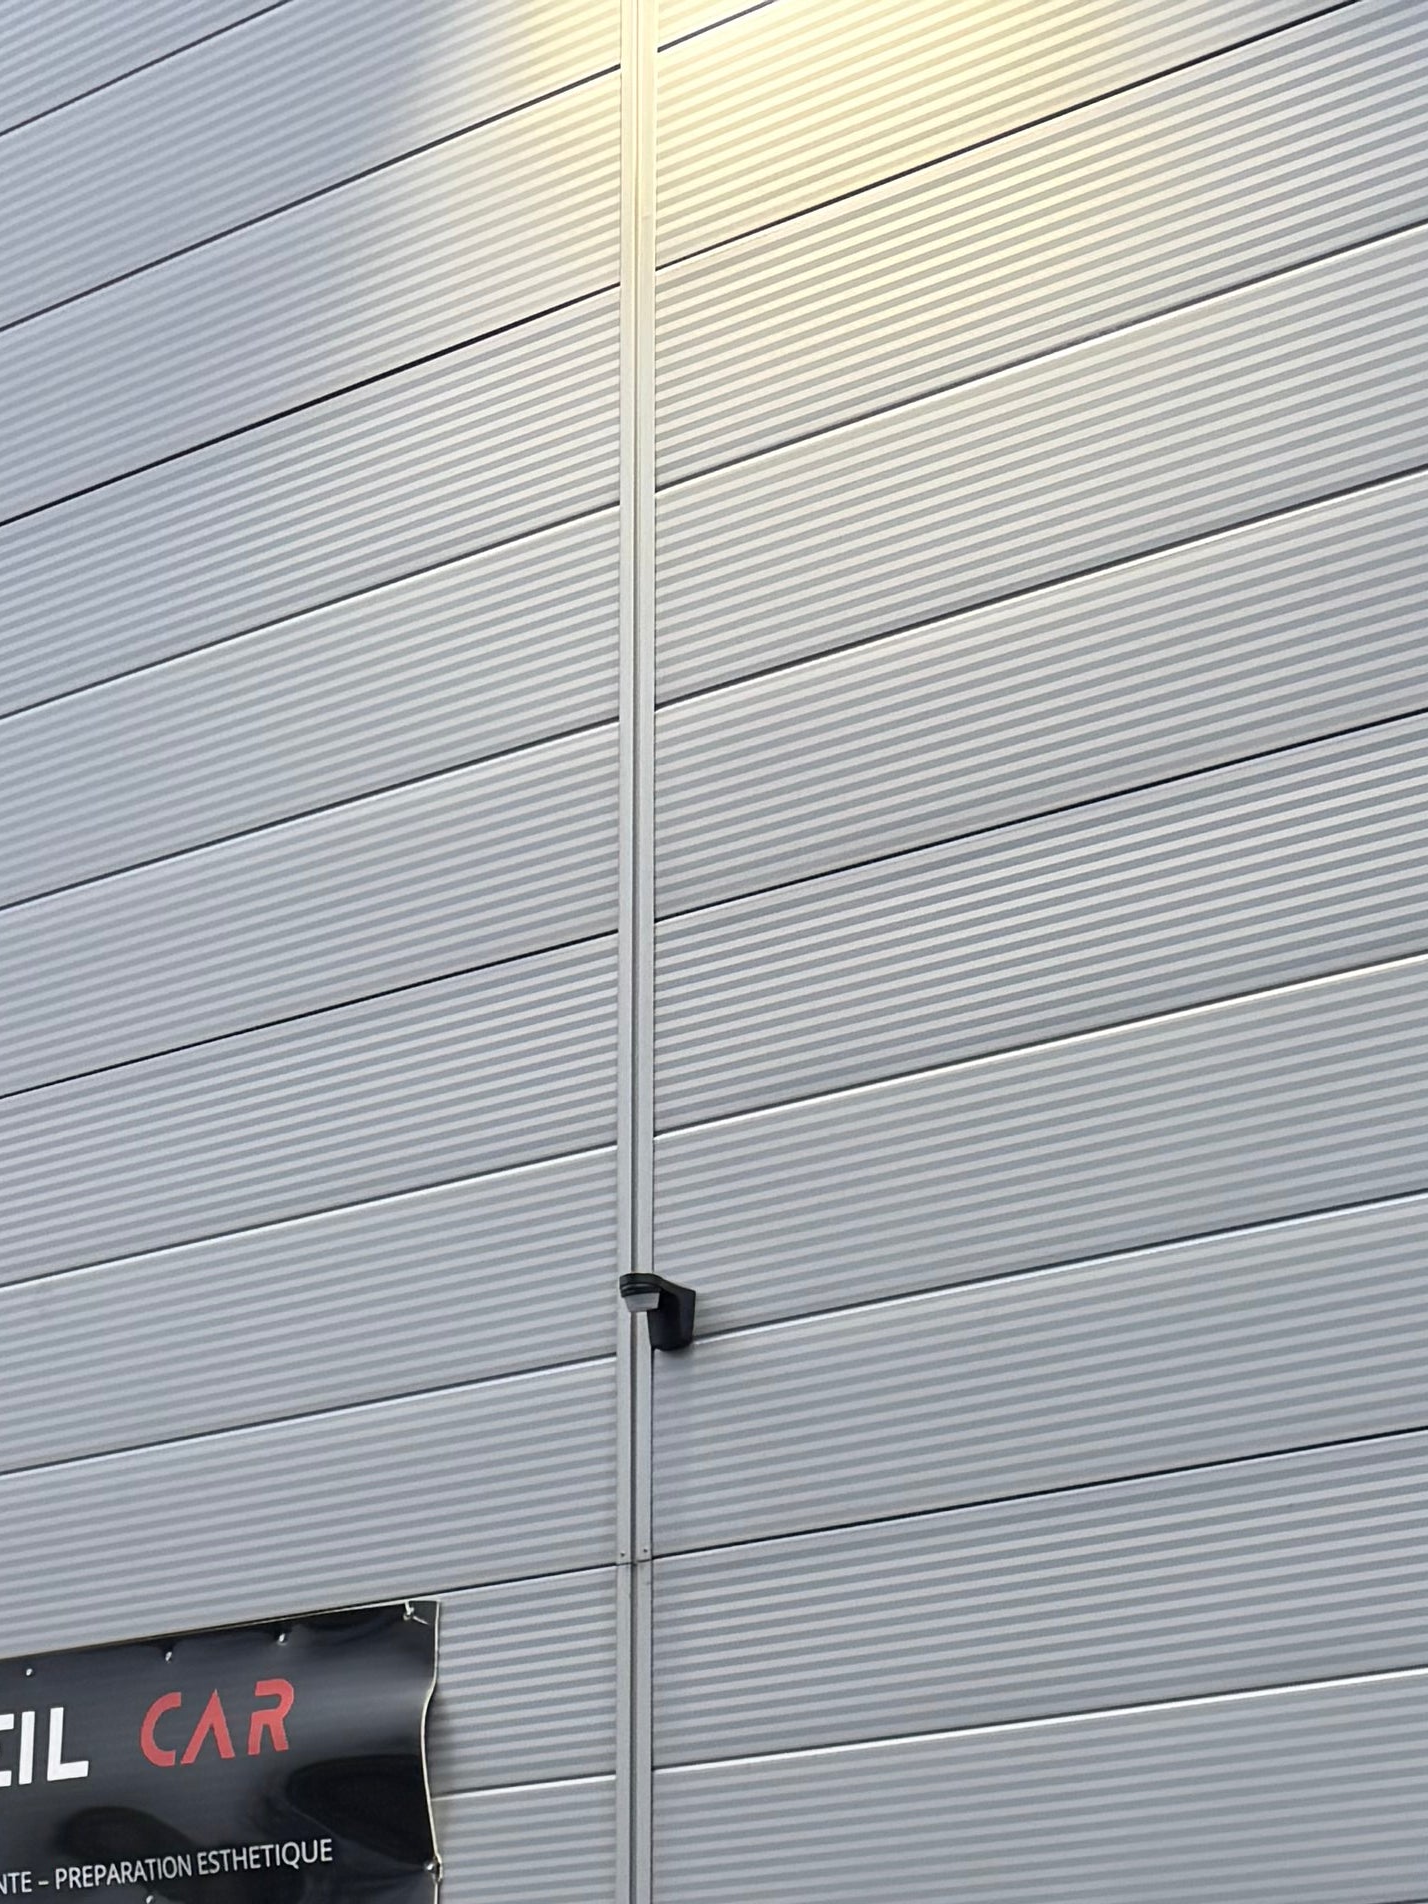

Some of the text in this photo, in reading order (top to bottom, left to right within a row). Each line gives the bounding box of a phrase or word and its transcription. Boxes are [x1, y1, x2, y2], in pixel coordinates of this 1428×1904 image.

[140, 1678, 295, 1767] CAR
[55, 1854, 193, 1890] PREPARATION
[197, 1838, 333, 1875] ESTHETIQUE
